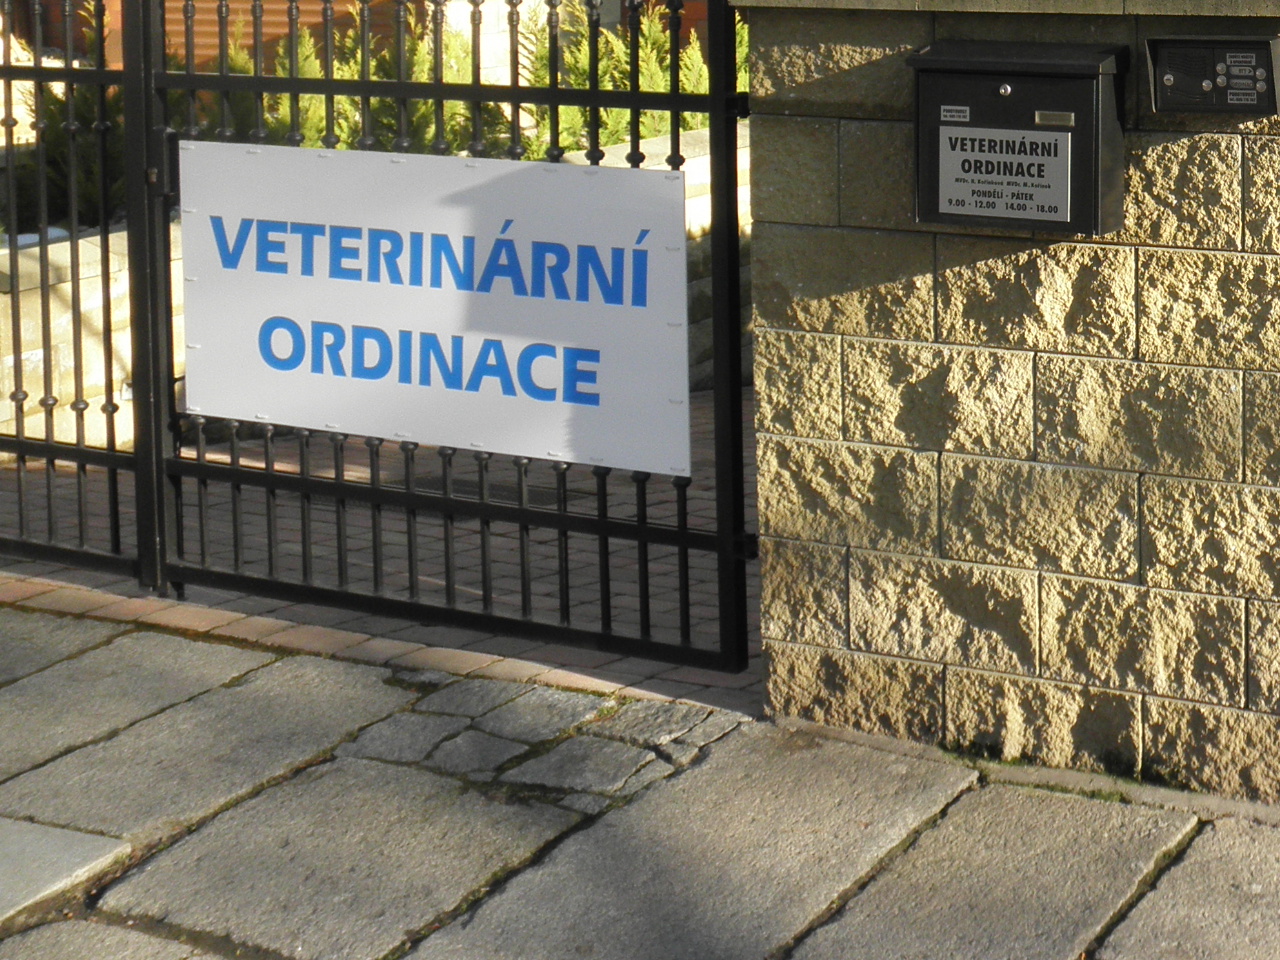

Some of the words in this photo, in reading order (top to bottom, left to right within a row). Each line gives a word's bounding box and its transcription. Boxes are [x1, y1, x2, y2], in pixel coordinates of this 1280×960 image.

[948, 136, 1059, 158] VETERINÁRNÍ
[960, 158, 1045, 179] ORDINACE
[1011, 190, 1034, 201] PÁTEK
[947, 199, 966, 208] 9.00
[974, 200, 996, 209] 12.00
[1005, 202, 1027, 212] 14.00
[1036, 204, 1059, 214] 18.00
[208, 215, 652, 308] VETERINÁRNÍ
[257, 315, 601, 407] ORDINACE
